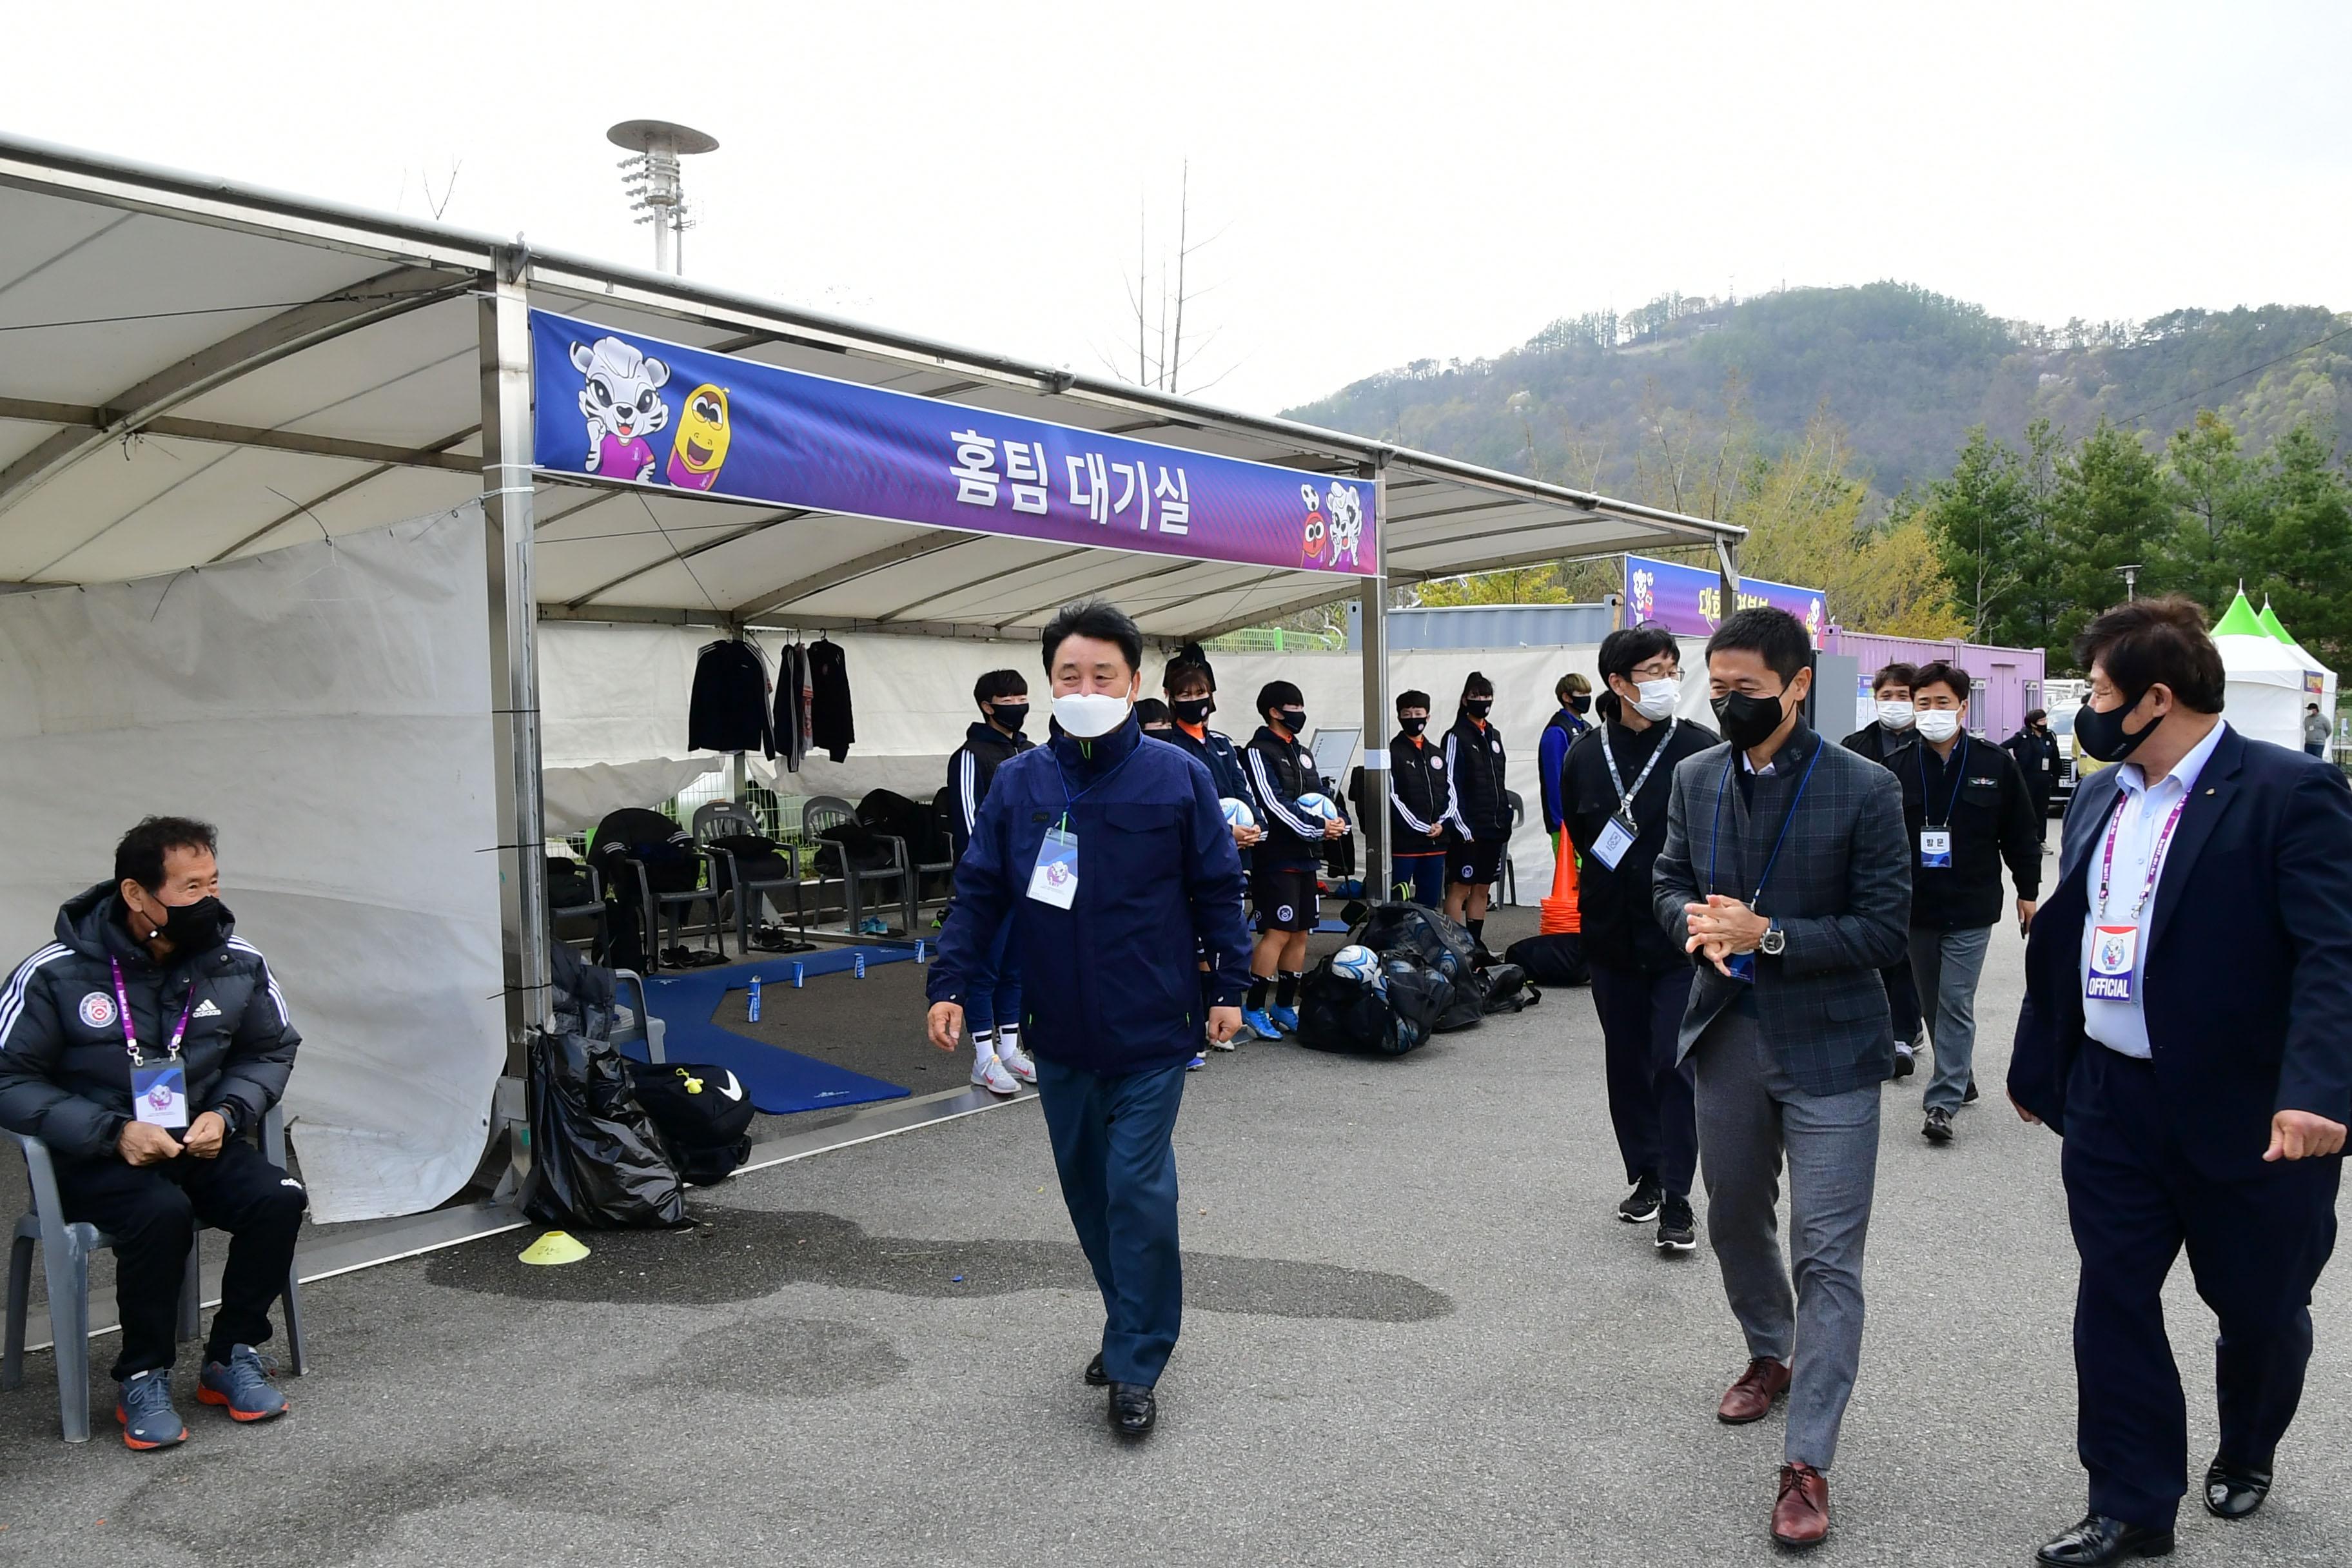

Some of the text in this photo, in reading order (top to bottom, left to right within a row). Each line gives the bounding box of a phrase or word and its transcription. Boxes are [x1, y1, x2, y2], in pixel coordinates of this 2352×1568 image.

[949, 429, 1190, 535] 홈팀 대기실
[2088, 977, 2130, 998] OFFICIAL
[192, 1008, 222, 1019] adidas
